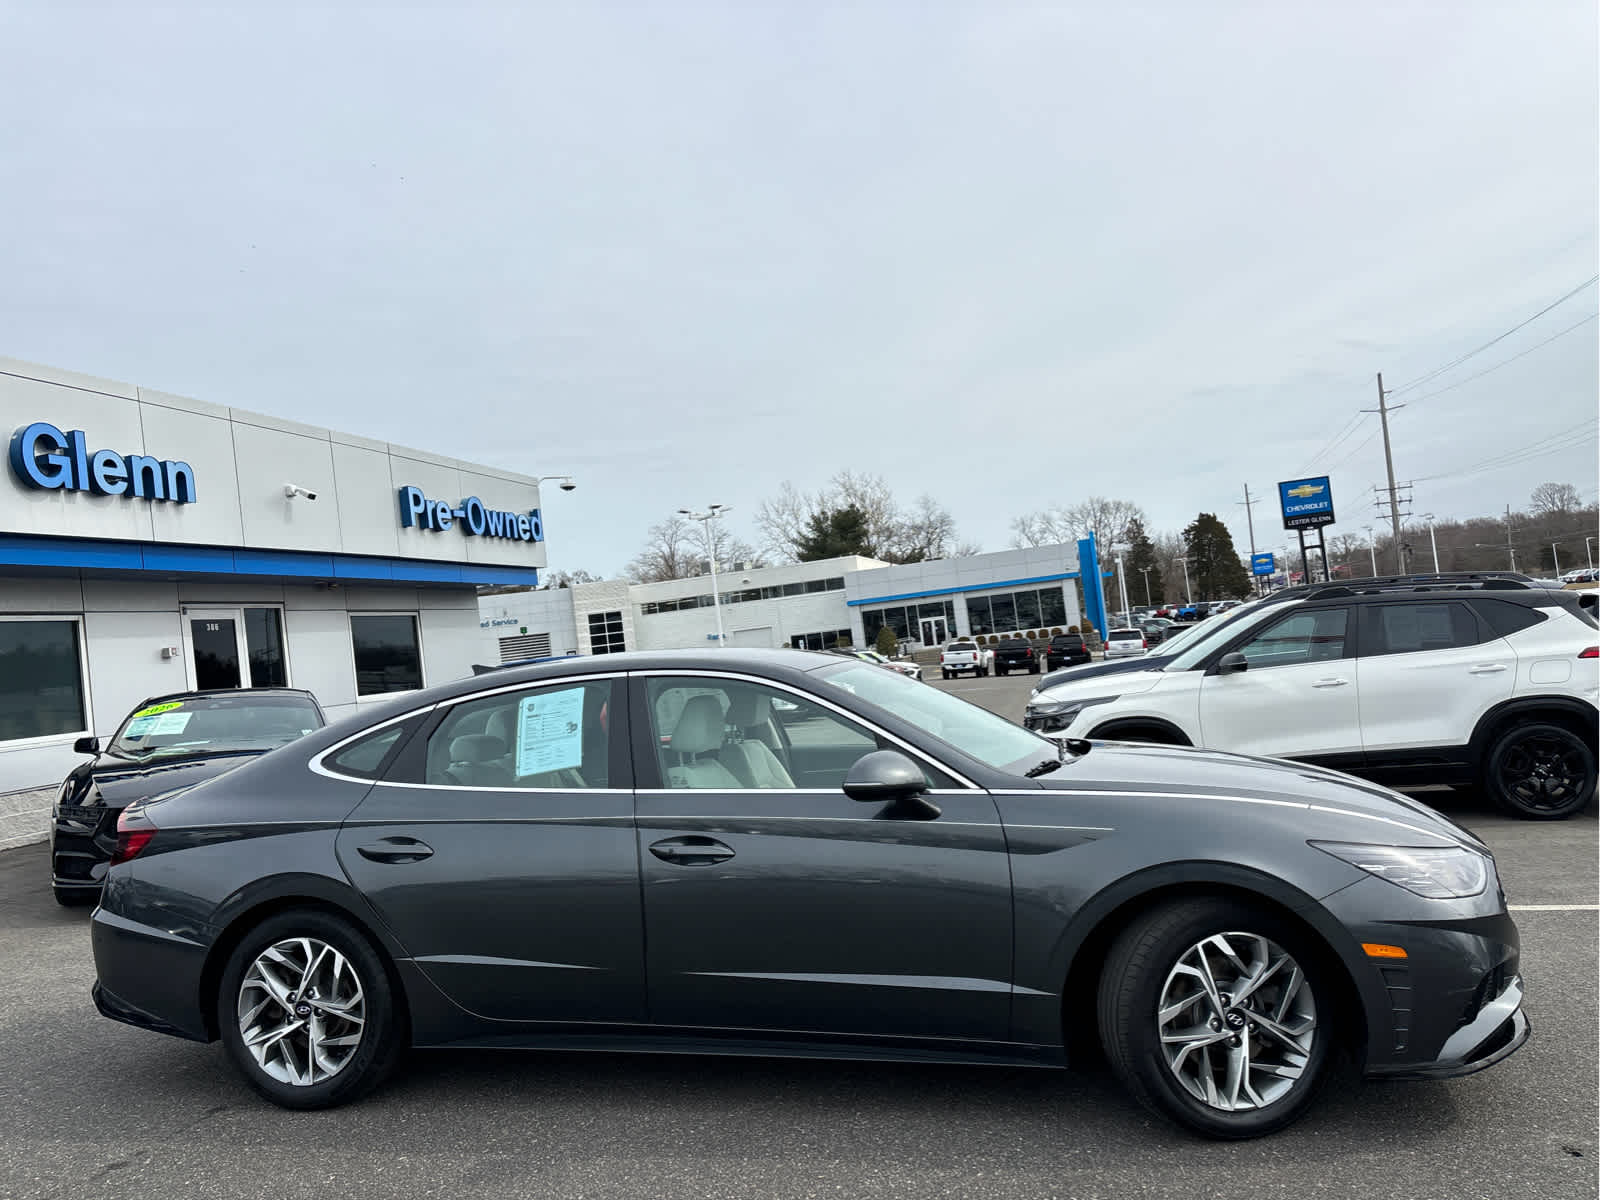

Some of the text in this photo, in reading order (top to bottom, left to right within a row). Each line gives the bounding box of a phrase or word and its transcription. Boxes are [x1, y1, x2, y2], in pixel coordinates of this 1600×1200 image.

[9, 422, 544, 542] Glenn Pre-Owned
[1286, 501, 1329, 513] CHEVROLET
[492, 618, 519, 626] Service
